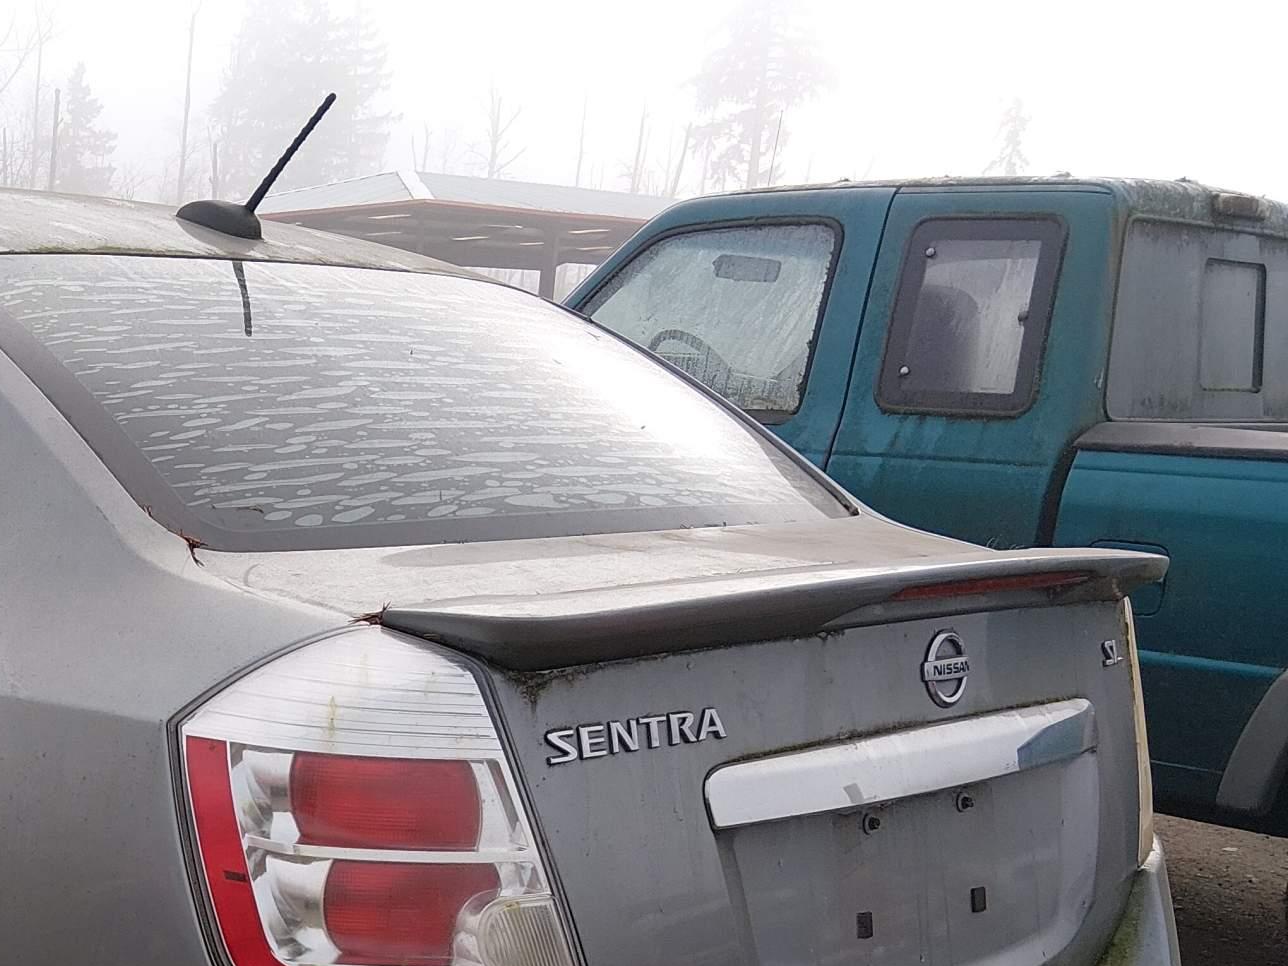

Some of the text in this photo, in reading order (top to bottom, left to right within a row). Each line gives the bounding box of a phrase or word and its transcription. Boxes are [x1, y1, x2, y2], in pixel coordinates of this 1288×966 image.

[1102, 640, 1118, 666] SL
[933, 660, 970, 676] NISSAN
[545, 707, 727, 765] SENTRA
